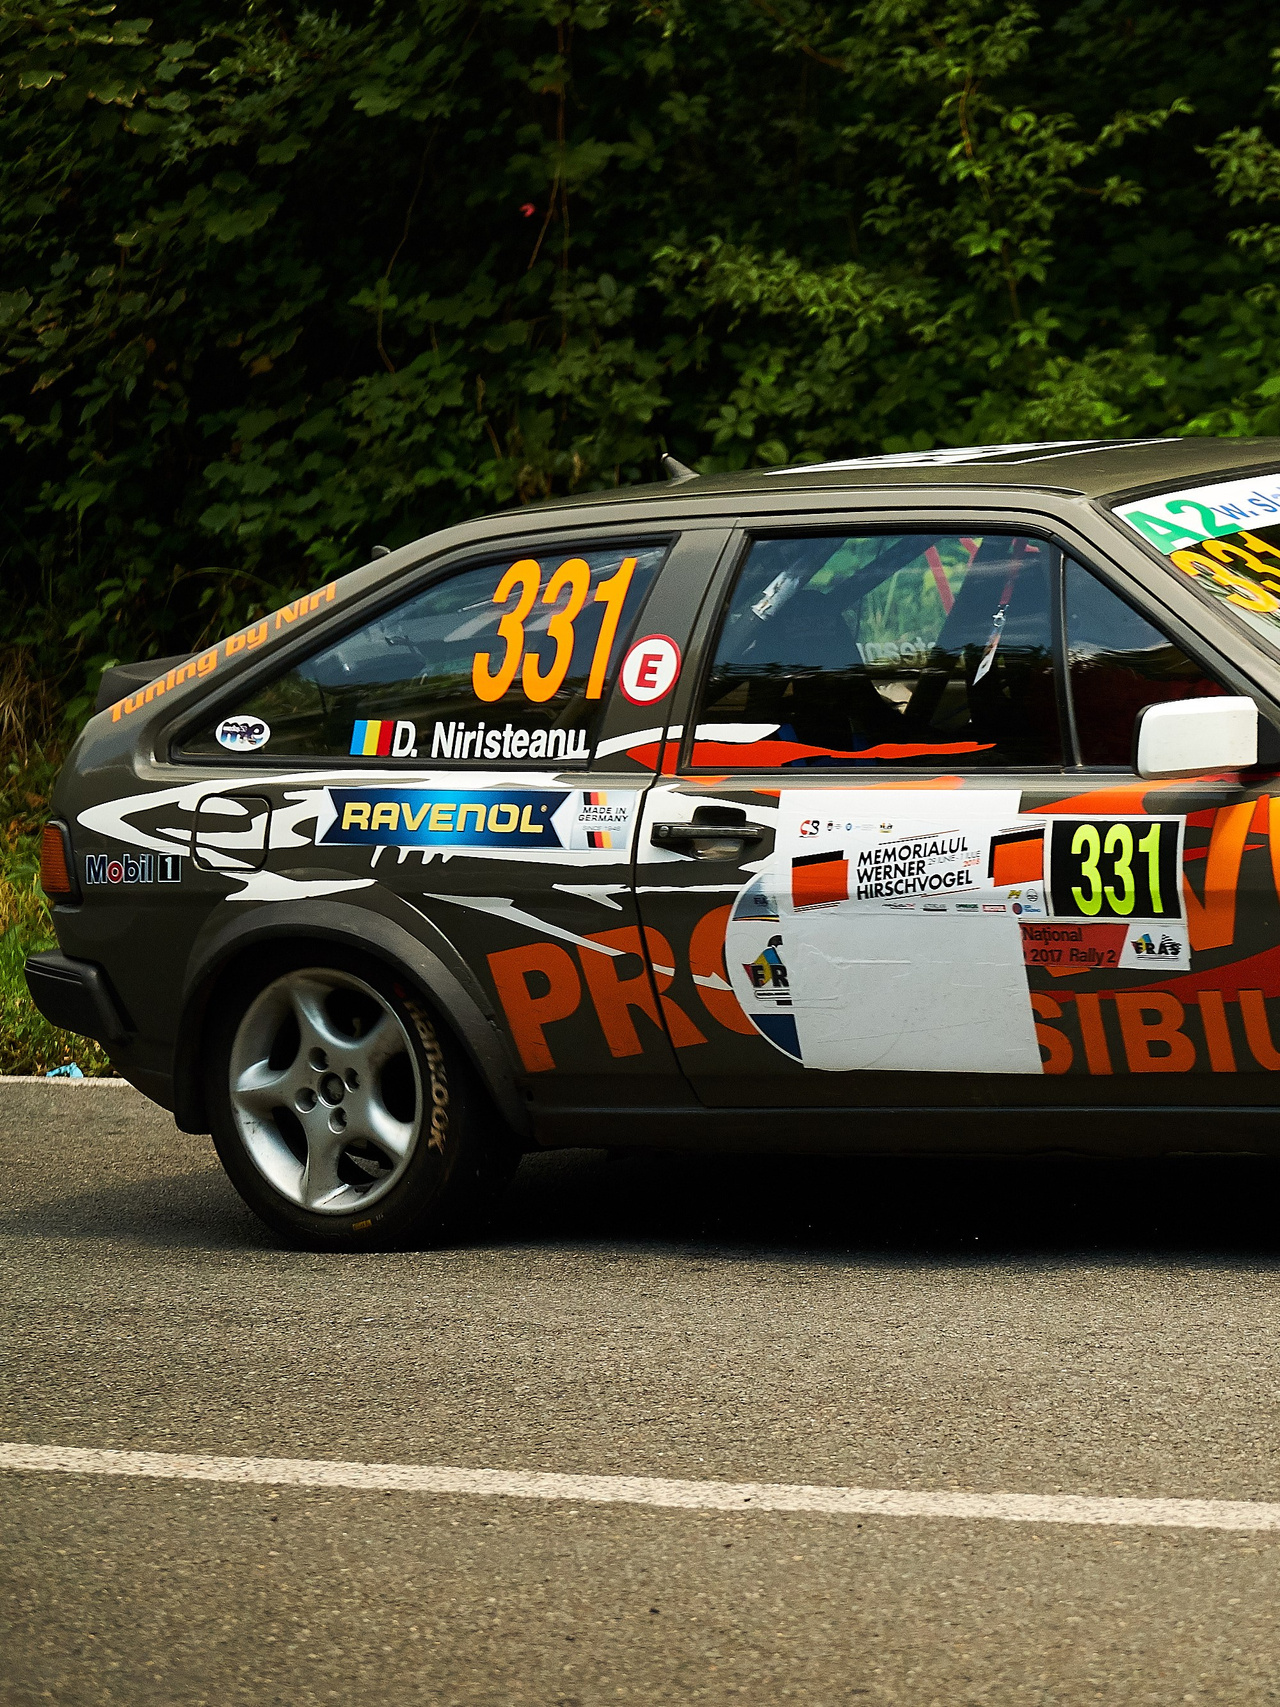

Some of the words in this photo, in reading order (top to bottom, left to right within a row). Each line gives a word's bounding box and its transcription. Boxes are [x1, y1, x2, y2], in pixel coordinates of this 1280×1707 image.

[1125, 499, 1246, 556] A2
[472, 557, 638, 703] 331
[109, 649, 219, 724] Tuning
[225, 621, 268, 657] by
[635, 653, 664, 689] E
[391, 720, 418, 759] D.
[431, 721, 588, 760] Niristeanu
[341, 801, 545, 834] RAVENOL
[578, 814, 629, 822] GERMANY
[582, 806, 613, 815] MADE
[615, 807, 627, 815] IN
[857, 836, 969, 867] MEMORIALUL
[85, 853, 154, 885] Mobil
[856, 860, 927, 884] WERNER
[856, 869, 973, 901] HIRSCHVOGEL
[1070, 823, 1165, 916] 331
[1030, 948, 1063, 963] 2017
[1069, 947, 1105, 967] Rally
[1106, 949, 1117, 964] 2
